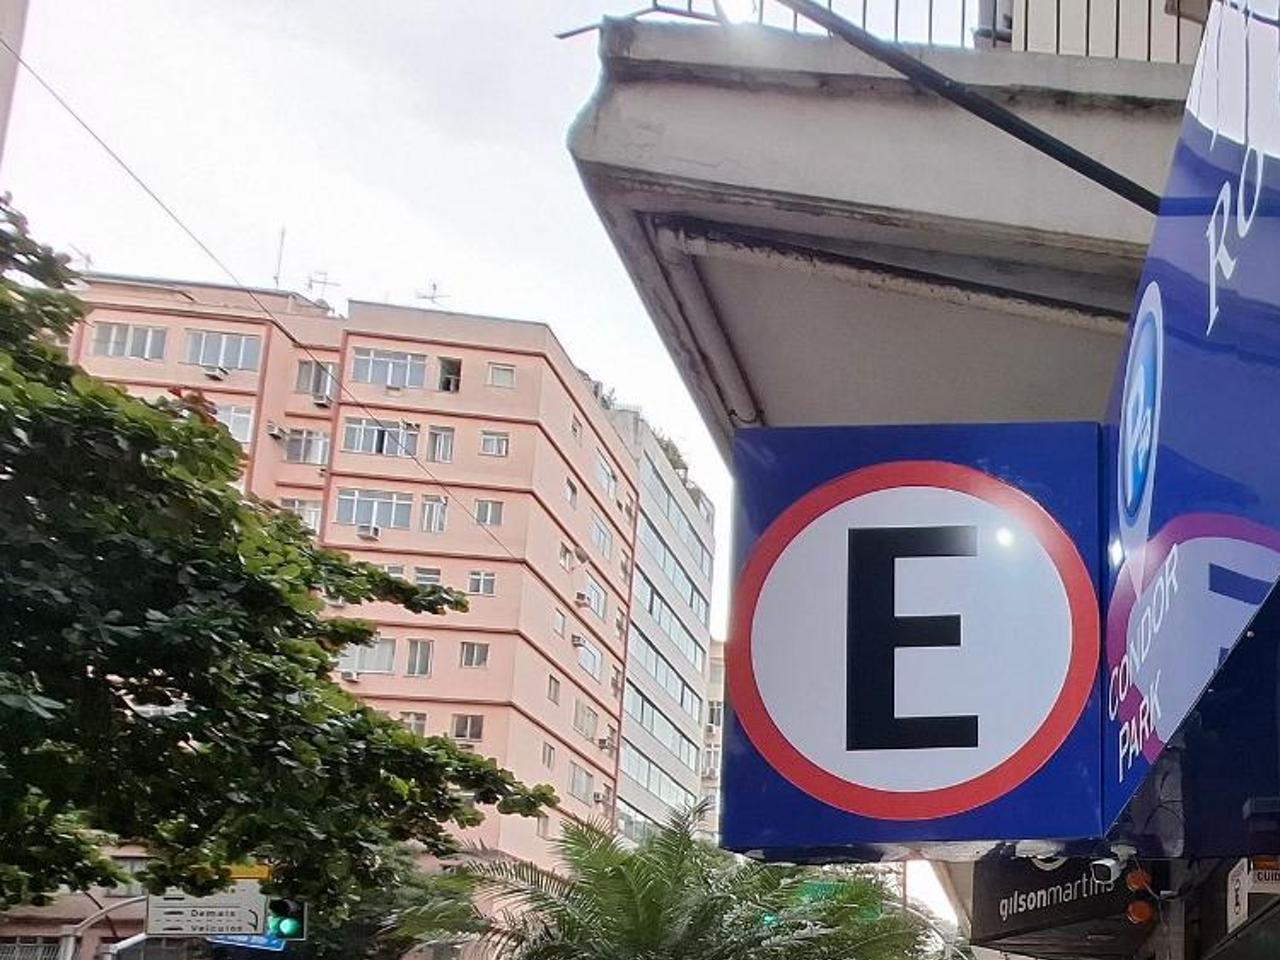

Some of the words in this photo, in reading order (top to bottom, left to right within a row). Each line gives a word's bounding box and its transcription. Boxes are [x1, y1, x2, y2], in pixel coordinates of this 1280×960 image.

[846, 525, 979, 751] E
[1108, 542, 1179, 722] CONDOR
[1118, 668, 1162, 783] PARK
